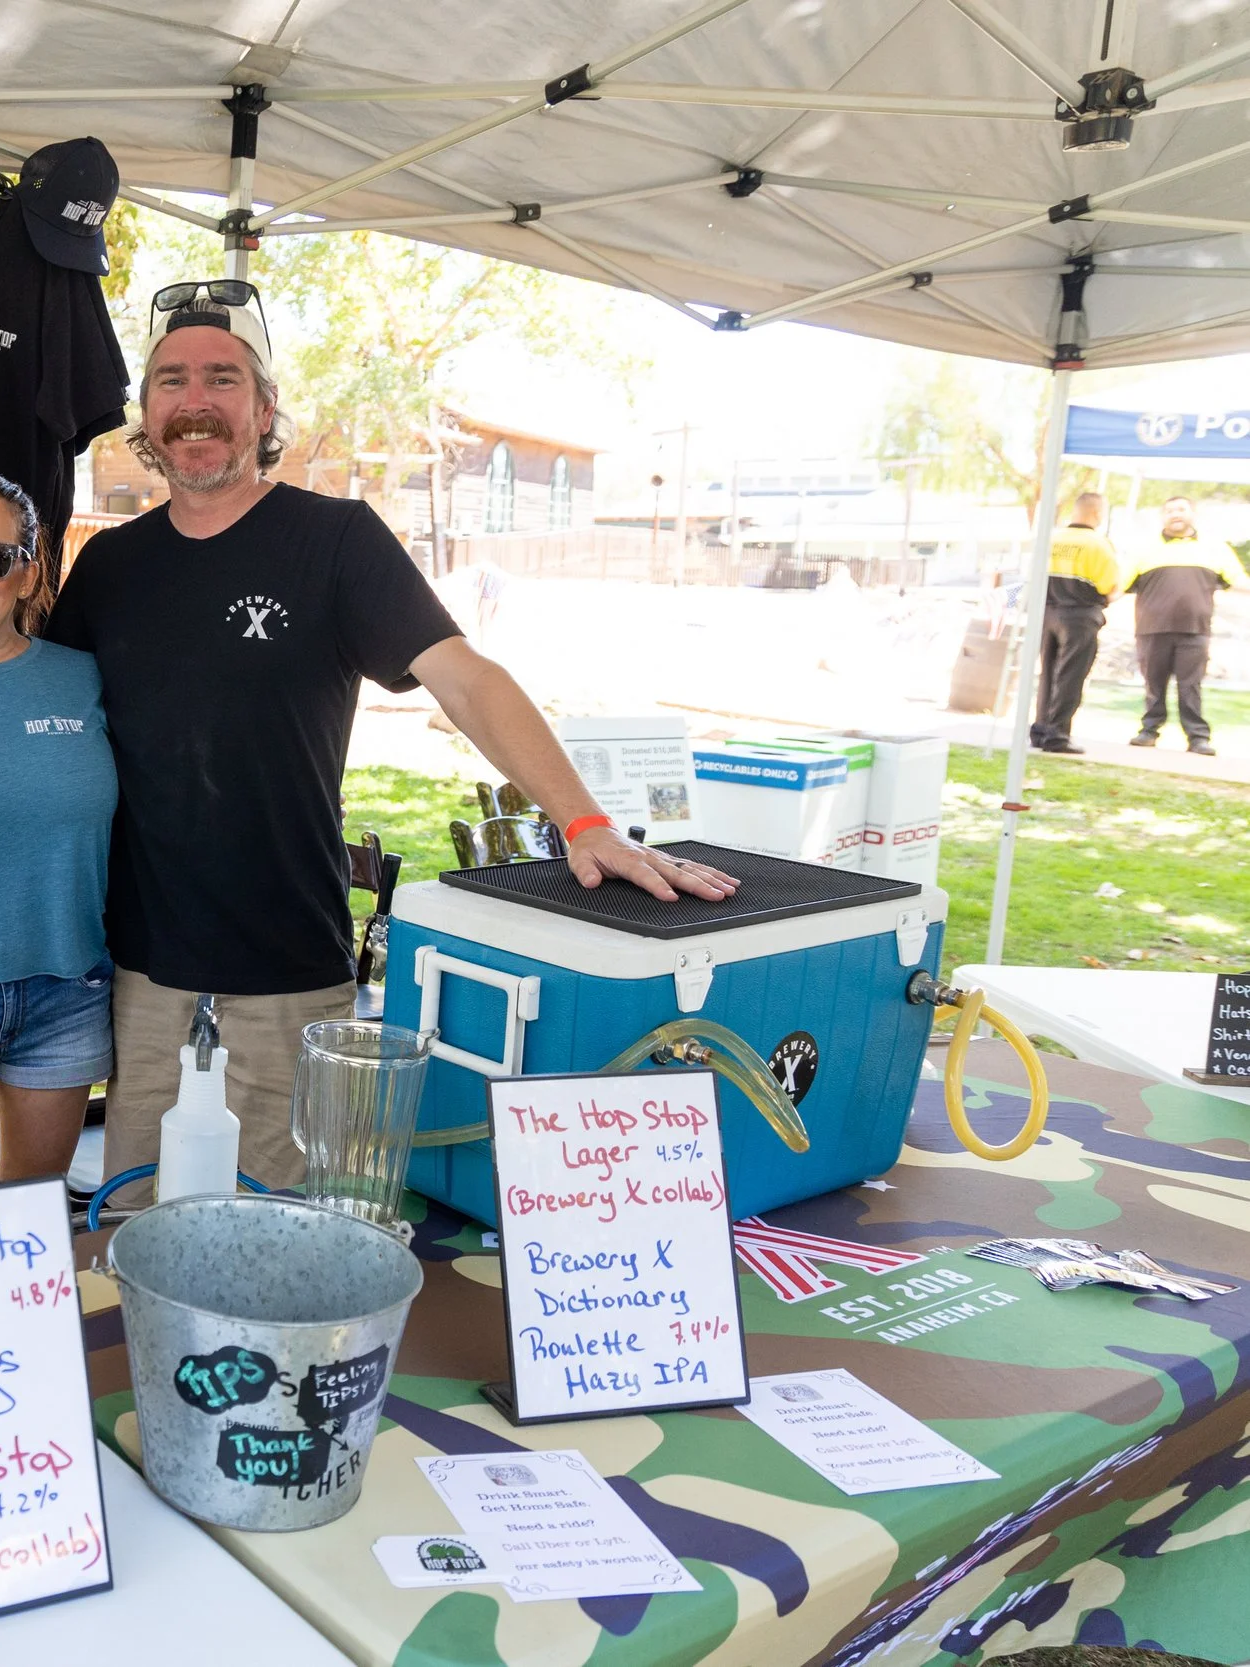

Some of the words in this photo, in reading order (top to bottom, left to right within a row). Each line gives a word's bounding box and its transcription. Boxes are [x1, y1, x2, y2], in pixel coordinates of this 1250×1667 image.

[61, 201, 87, 221] HOP
[229, 595, 288, 617] BREWERY
[242, 607, 271, 640] X
[24, 719, 50, 735] HOP
[53, 719, 84, 732] STOP
[703, 761, 761, 776] RECYCLABLES
[762, 769, 788, 779] ONLY
[893, 825, 939, 845] EDCO
[769, 1040, 817, 1070] BREWERY
[508, 1106, 568, 1135] The
[579, 1099, 639, 1136] Hop
[643, 1100, 709, 1135] Stop
[562, 1141, 639, 1181] Lager
[656, 1140, 704, 1162] 4.5%
[506, 1184, 617, 1223] (Brewery
[624, 1177, 648, 1206] X
[652, 1170, 726, 1211] collab)
[524, 1241, 639, 1281] Brewery
[652, 1239, 674, 1269] X
[10, 1271, 72, 1310] 4.8%
[534, 1284, 691, 1317] Dictionary
[819, 1294, 905, 1326] EST.
[887, 1268, 974, 1302] 2018
[876, 1302, 992, 1345] ANAHEIM,
[978, 1290, 1021, 1307] CA
[519, 1325, 646, 1362] Roulette
[669, 1315, 730, 1346] 7.4%
[178, 1349, 266, 1409] TIPS
[314, 1360, 379, 1390] Feeling
[565, 1365, 641, 1398] Hazy
[653, 1356, 709, 1386] IPA
[775, 1405, 811, 1416] Drink
[813, 1401, 857, 1412] Smart.
[783, 1415, 807, 1425] Get
[808, 1413, 844, 1424] Home
[846, 1410, 877, 1420] Safe.
[228, 1432, 315, 1455] Thank
[812, 1431, 846, 1440] Need
[858, 1425, 887, 1435] ride?
[816, 1445, 844, 1455] Call
[846, 1442, 874, 1452] Uber
[892, 1436, 925, 1449] Lyft.
[827, 1459, 857, 1469] Your
[858, 1456, 892, 1467] safety
[893, 1454, 907, 1463] is
[907, 1451, 941, 1461] worth
[477, 1491, 520, 1502] Drink
[522, 1488, 572, 1500] Smart.
[481, 1503, 508, 1513] Get
[511, 1502, 552, 1513] Home
[555, 1499, 591, 1510] Safe.
[505, 1522, 544, 1533] Need
[561, 1519, 595, 1529] ride?
[502, 1541, 532, 1552] Call
[534, 1540, 571, 1550] Uber
[574, 1540, 591, 1548] or
[594, 1536, 631, 1548] Lyft.
[424, 1558, 449, 1569] HOP
[450, 1558, 481, 1569] STOP
[543, 1559, 583, 1570] safety
[585, 1558, 599, 1567] is
[602, 1555, 641, 1567] worth
